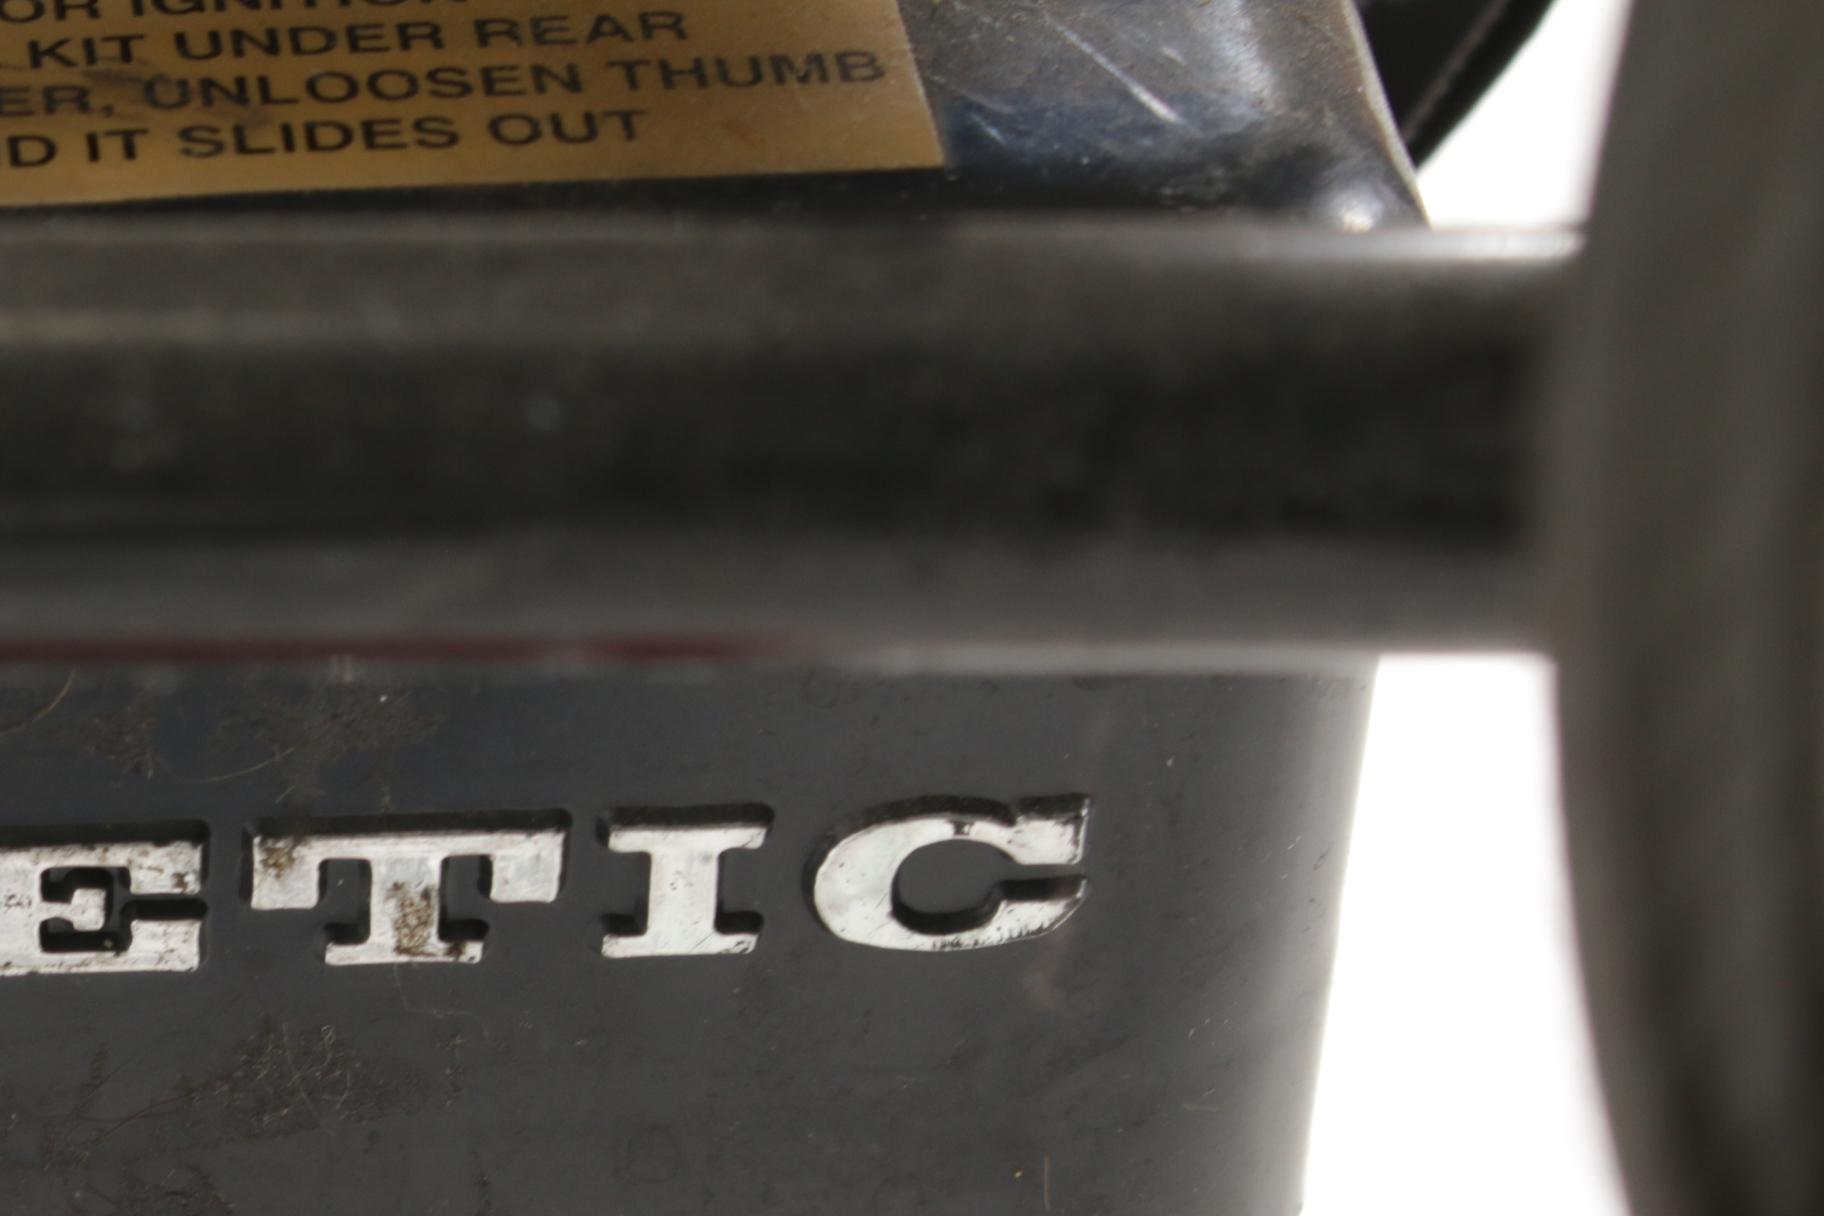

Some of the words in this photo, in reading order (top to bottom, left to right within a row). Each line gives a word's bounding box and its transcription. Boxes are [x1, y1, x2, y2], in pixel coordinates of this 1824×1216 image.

[27, 34, 145, 69] KIT
[173, 20, 445, 61] UNDER
[473, 10, 688, 48] REAR
[141, 62, 583, 110] UNLOOSEN
[606, 50, 887, 93] THUMB
[85, 128, 149, 164] IT
[177, 114, 460, 160] SLIDES
[487, 108, 647, 147] OUT
